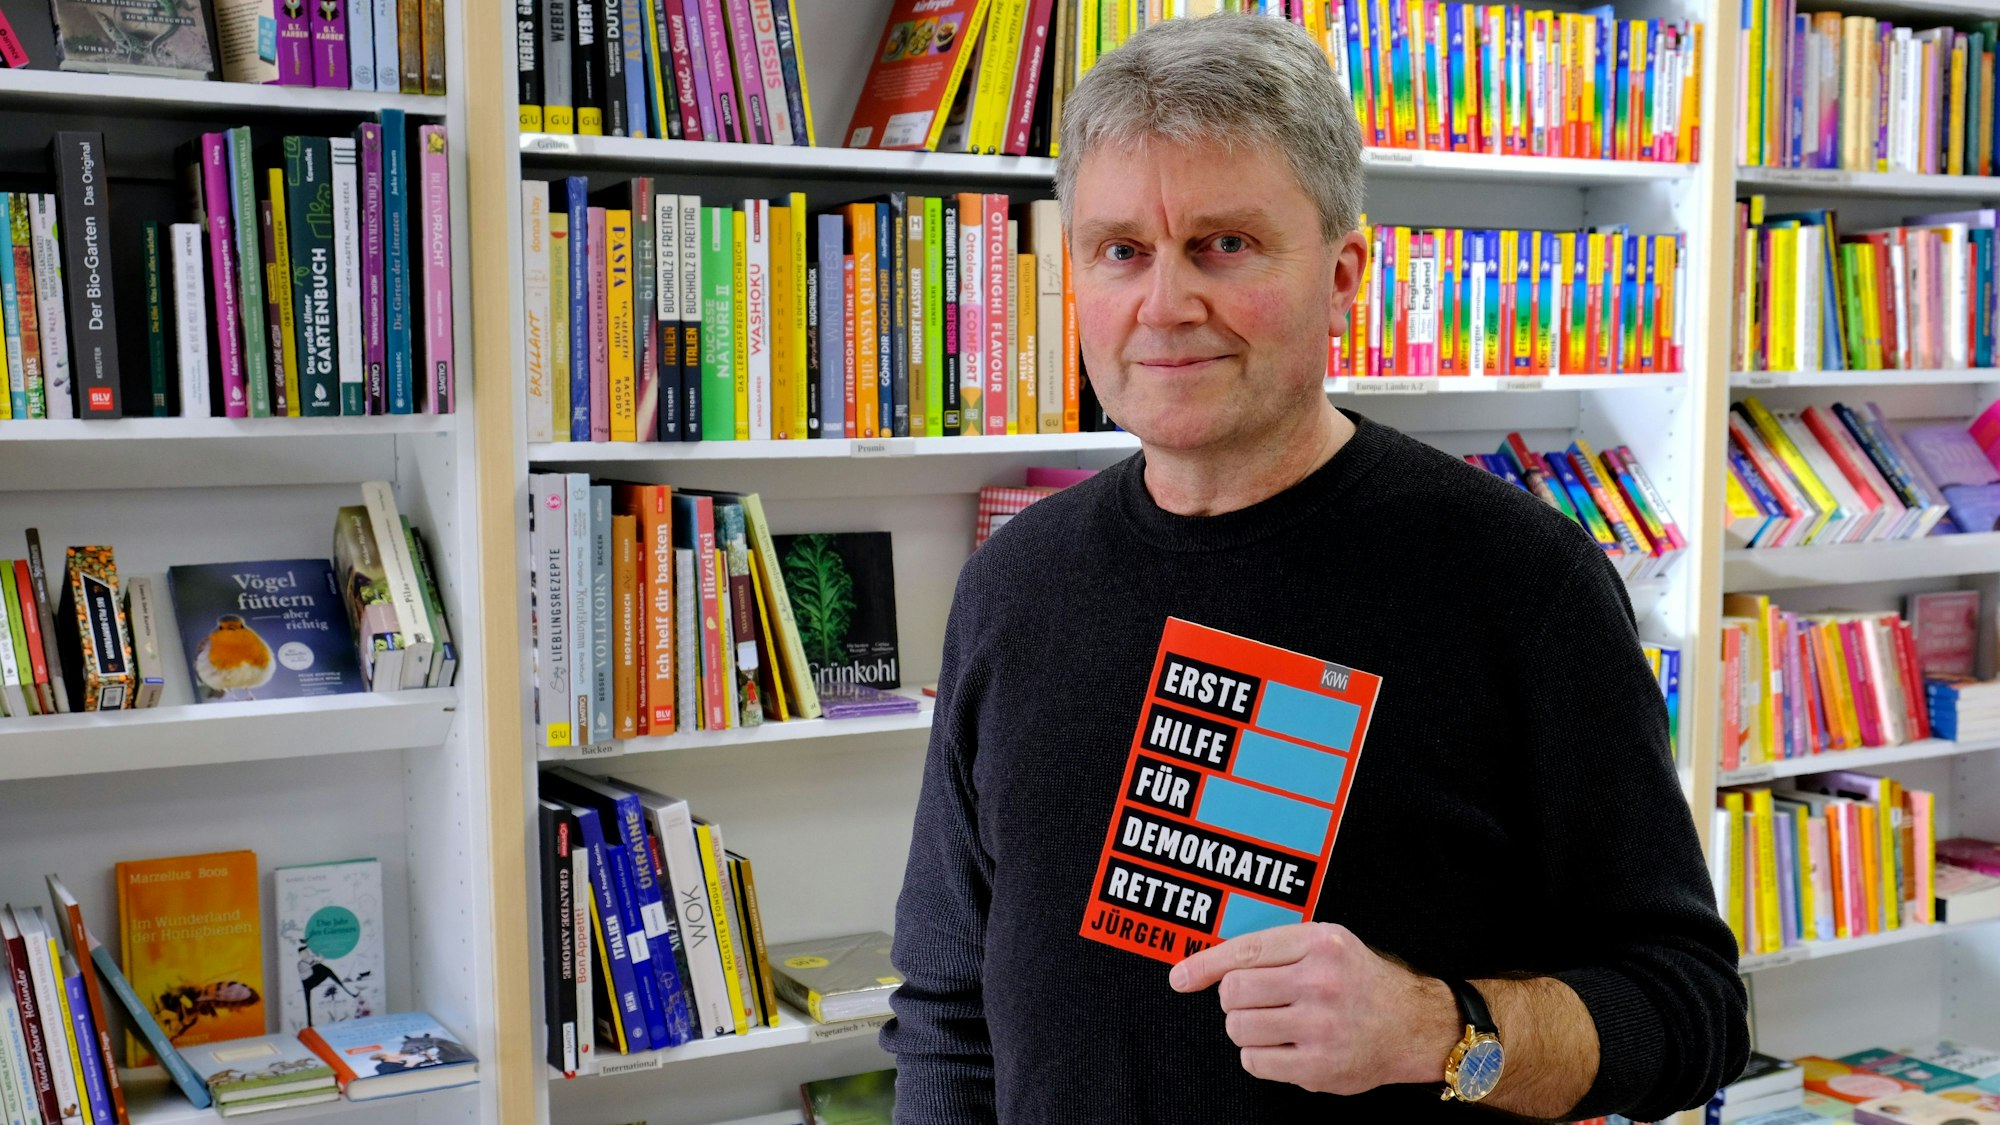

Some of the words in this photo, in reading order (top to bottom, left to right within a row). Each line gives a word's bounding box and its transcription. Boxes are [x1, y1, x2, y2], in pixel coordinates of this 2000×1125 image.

[519, 21, 535, 72] WEBER'S
[761, 39, 782, 89] SISSI
[980, 69, 994, 96] Meal
[990, 16, 1002, 43] WITH
[998, 71, 1012, 97] Meal
[1007, 18, 1018, 44] WITH
[1029, 45, 1041, 82] rainbow
[1025, 83, 1035, 99] the
[519, 114, 539, 125] GU
[551, 114, 570, 125] GU
[582, 115, 601, 126] GU
[720, 94, 732, 125] CALLWEY
[750, 95, 763, 127] CALLWEY
[79, 142, 92, 178] Original
[537, 140, 569, 150] Grillen
[84, 183, 95, 206] Das
[241, 179, 250, 195] VON
[342, 181, 350, 205] SEELE
[242, 197, 252, 226] GÄRTEN
[529, 196, 543, 216] hay
[391, 211, 402, 256] Literaten
[531, 218, 542, 253] donna
[661, 206, 673, 248] FREITAG
[683, 207, 696, 249] FREITAG
[83, 216, 102, 299] Bio-Garten
[220, 239, 235, 305] Landhausgarten
[391, 258, 401, 275] der
[612, 226, 627, 288] PASTA
[963, 232, 977, 304] Ottolenghi
[990, 211, 1004, 315] OTTOLENGHI
[1022, 261, 1031, 284] Klink
[392, 276, 403, 311] Gärten
[595, 271, 604, 310] EINFACH
[662, 259, 675, 314] BUCHHOLZ
[684, 260, 697, 314] BUCHHOLZ
[824, 241, 840, 343] WINTERFEST
[859, 251, 873, 306] QUEEN
[878, 269, 889, 301] MEHR!
[910, 267, 922, 319] KLASSIKER
[945, 258, 957, 302] SCHNELLE
[1408, 261, 1418, 311] England
[1422, 261, 1433, 311] England
[303, 294, 314, 324] Ulmer
[311, 247, 333, 375] GARTENBUCH
[750, 263, 762, 356] WASHOKU
[807, 268, 818, 326] KUCHENGLÜCK
[845, 293, 854, 318] TIME
[1023, 285, 1031, 316] Vincent
[88, 302, 104, 331] Der
[225, 306, 238, 354] traumhafter
[393, 313, 403, 331] Die
[596, 311, 605, 343] KOCHT
[704, 299, 717, 364] DUCASSE
[845, 320, 854, 338] TEA
[860, 308, 874, 356] PASTA
[879, 302, 890, 334] NOCH
[946, 303, 957, 355] HENSSLERS
[1518, 315, 1528, 352] Elsass
[304, 325, 316, 354] große
[528, 310, 543, 398] BRILLANT
[555, 322, 565, 364] KOCHEN
[664, 327, 677, 366] ITALIEN
[685, 327, 698, 367] ITALIEN
[716, 301, 731, 378] NATURE
[879, 336, 890, 354] DIR
[911, 319, 923, 365] HUNDERT
[966, 309, 979, 383] COMFORT
[990, 321, 1004, 393] FLAVOUR
[1460, 338, 1468, 371] Wales
[1486, 312, 1498, 370] Bretagne
[1538, 322, 1549, 369] Korsika
[26, 357, 39, 389] WADAS
[94, 347, 104, 379] KREUTER
[229, 355, 240, 376] Mein
[306, 356, 316, 375] Das
[371, 363, 381, 397] CALLWEY
[845, 340, 855, 404] AFTERNOON
[861, 358, 874, 391] THE
[879, 355, 891, 387] GÖNN
[1019, 352, 1028, 381] MEIN
[1026, 335, 1036, 397] SCHWABEN
[91, 391, 111, 402] BLV
[615, 379, 623, 417] RODDY
[622, 376, 632, 420] RACHEL
[736, 374, 745, 393] DAS
[1356, 382, 1384, 392] Europa:
[30, 392, 41, 414] RENÉ
[1045, 419, 1059, 427] GU
[857, 443, 885, 452] Promis
[654, 523, 670, 583] backen
[699, 532, 717, 599] Hitzefrei
[232, 571, 297, 593] Vögel
[403, 582, 414, 604] Pilze
[654, 588, 670, 607] dir
[237, 593, 316, 610] füttern
[283, 610, 310, 620] aber
[549, 548, 563, 663] LIEBLINGSREZEPTE
[285, 619, 329, 632] richtig
[594, 572, 607, 669] VOLLKORN
[623, 593, 632, 666] BROTBACKBUCH
[655, 611, 670, 650] helf
[655, 653, 670, 681] Ich
[807, 658, 896, 684] Grünkohl
[1321, 668, 1350, 690] KiWi
[1163, 661, 1251, 714] ERSTE
[579, 696, 587, 727] CALLWEY
[655, 708, 671, 719] BLV
[550, 729, 567, 740] GU
[581, 744, 613, 755] Backen
[1149, 715, 1227, 765] HILFE
[1135, 765, 1191, 809] FÜR
[593, 842, 605, 866] Stories.
[625, 811, 653, 890] UKRAINE
[1121, 815, 1306, 895] DEMOKRATIE-
[198, 866, 229, 879] Boos
[559, 868, 571, 919] GRANDE
[710, 881, 724, 918] FONDUE
[1108, 866, 1213, 925] RETTER
[132, 919, 152, 931] Im
[155, 909, 241, 928] Wunderland
[132, 930, 158, 943] der
[161, 923, 253, 942] Honigbienen
[316, 917, 331, 928] Das
[574, 907, 587, 958] Appetit!
[680, 884, 710, 949] WOK
[1091, 907, 1177, 954] JÜRGEN
[560, 919, 572, 980] AMORE
[605, 914, 626, 961] ITALIEN
[719, 927, 733, 972] RACLETTE
[576, 959, 588, 984] Bon
[16, 967, 36, 1019] Holunder
[6, 1008, 17, 1028] HUND
[815, 1024, 858, 1039] Vegetarisch
[29, 1022, 51, 1092] Wunderbarer
[564, 1025, 573, 1054] CALLWEY
[3, 1069, 13, 1090] MEINE
[603, 1059, 658, 1074] International
